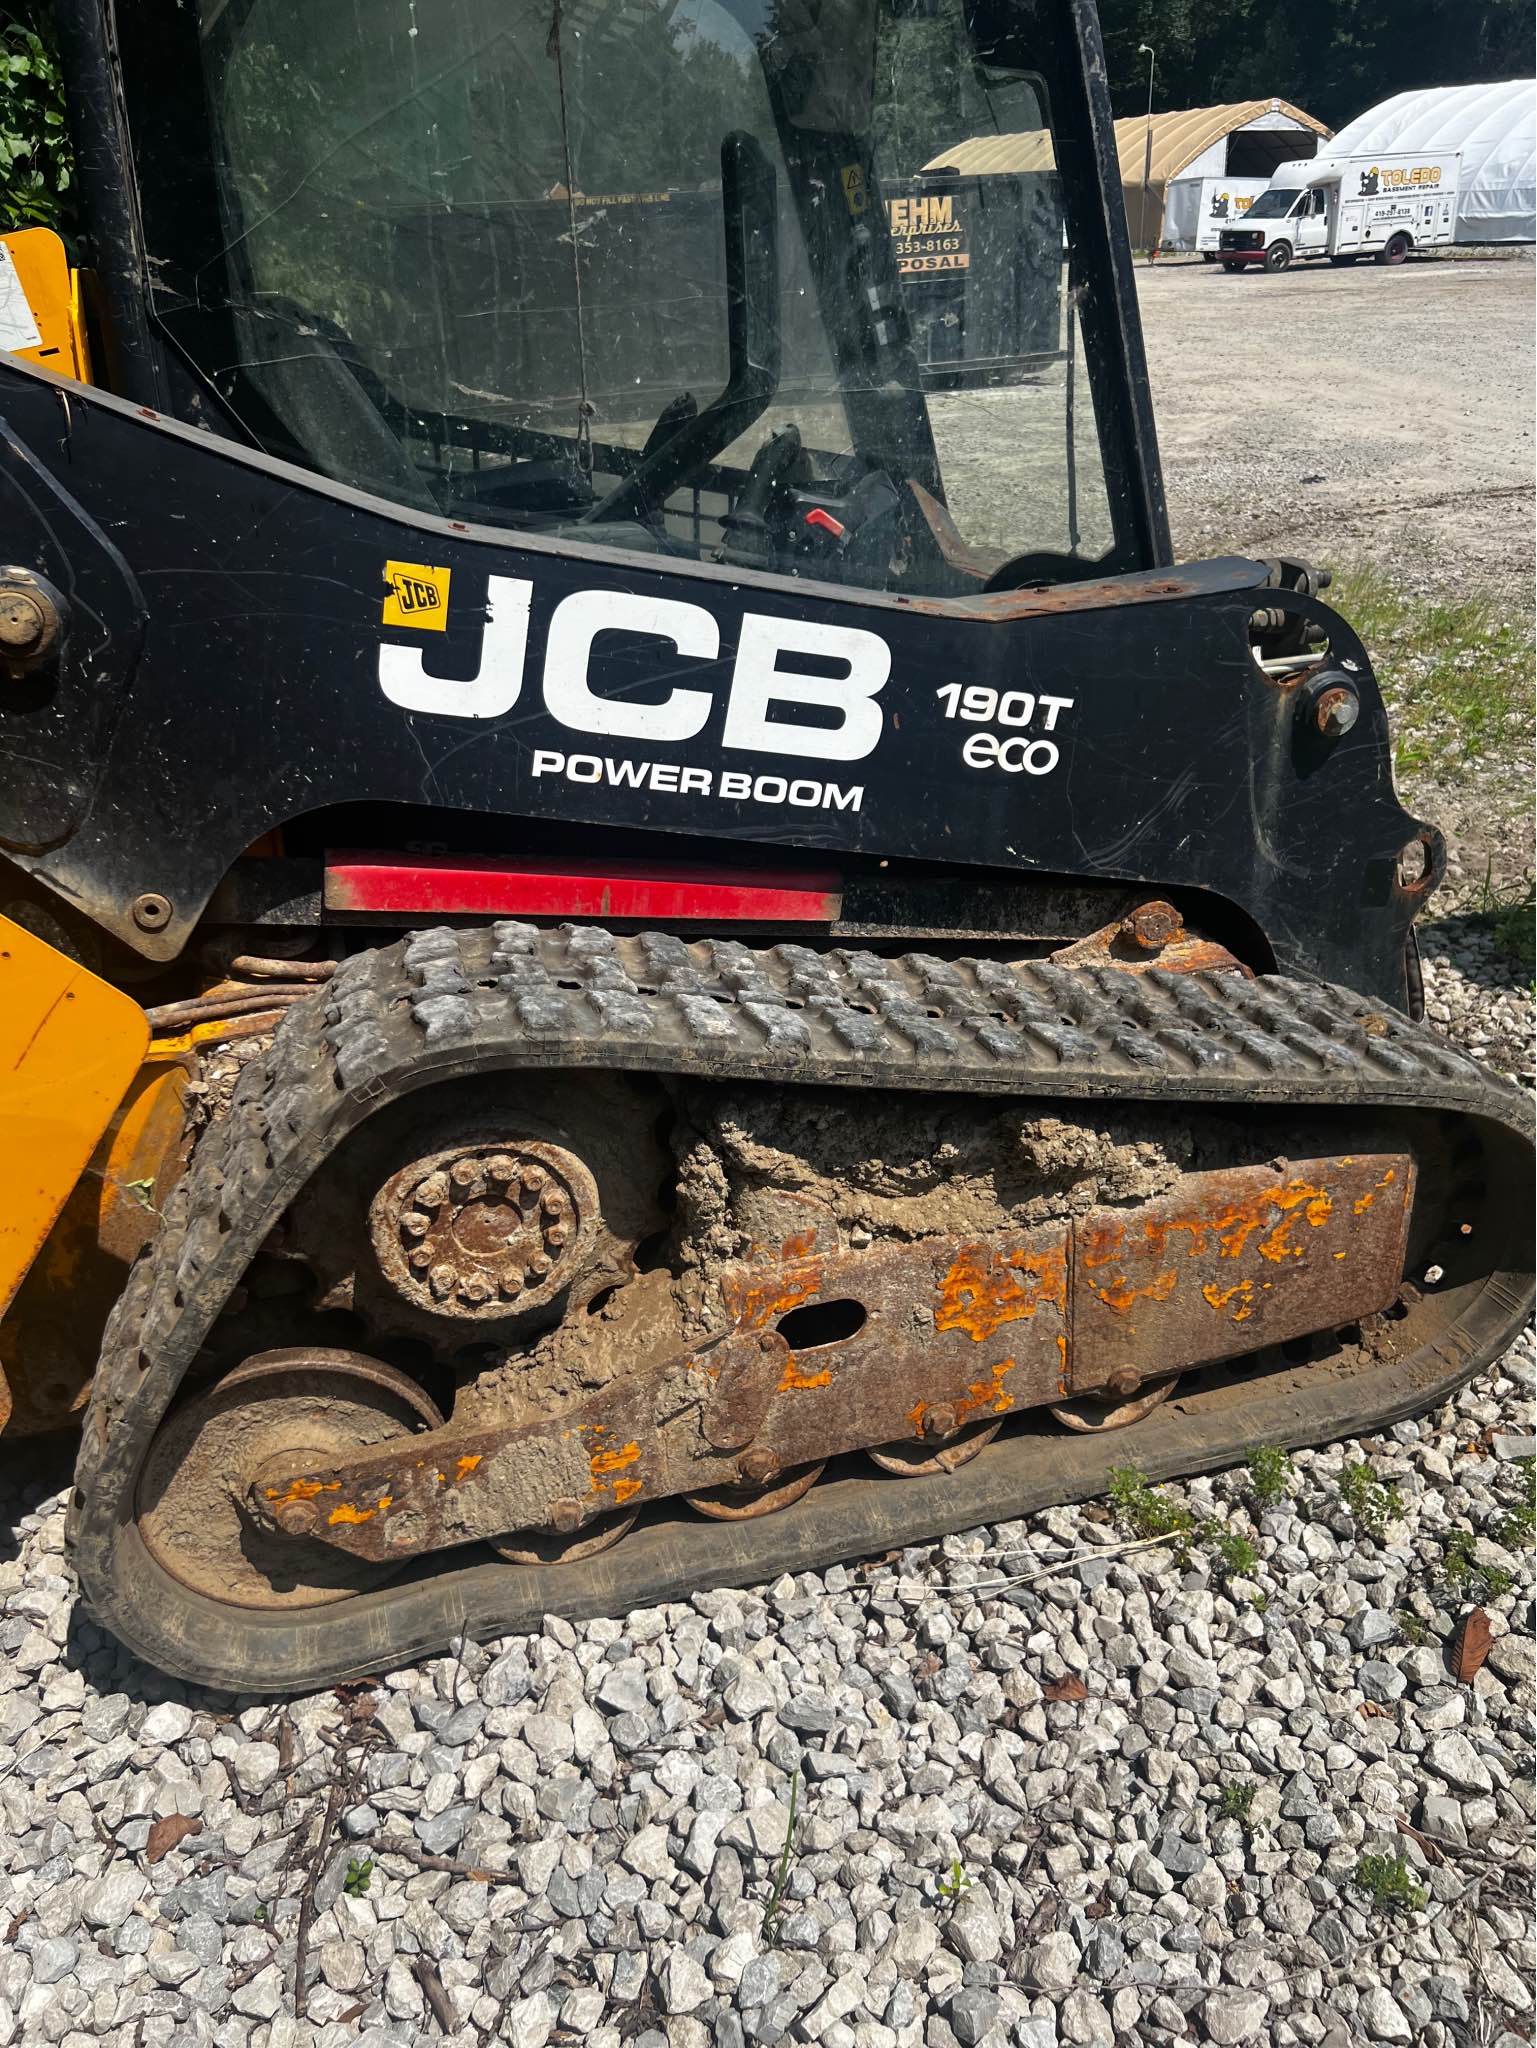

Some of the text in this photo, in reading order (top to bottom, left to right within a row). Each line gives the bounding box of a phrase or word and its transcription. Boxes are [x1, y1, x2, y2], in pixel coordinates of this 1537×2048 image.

[1381, 167, 1441, 186] TOLEDO
[885, 196, 952, 227] EHM
[896, 239, 959, 254] 353-8163
[402, 579, 437, 609] JCB
[378, 575, 893, 761] JCB
[936, 682, 1075, 731] 190T
[961, 731, 1060, 775] eco
